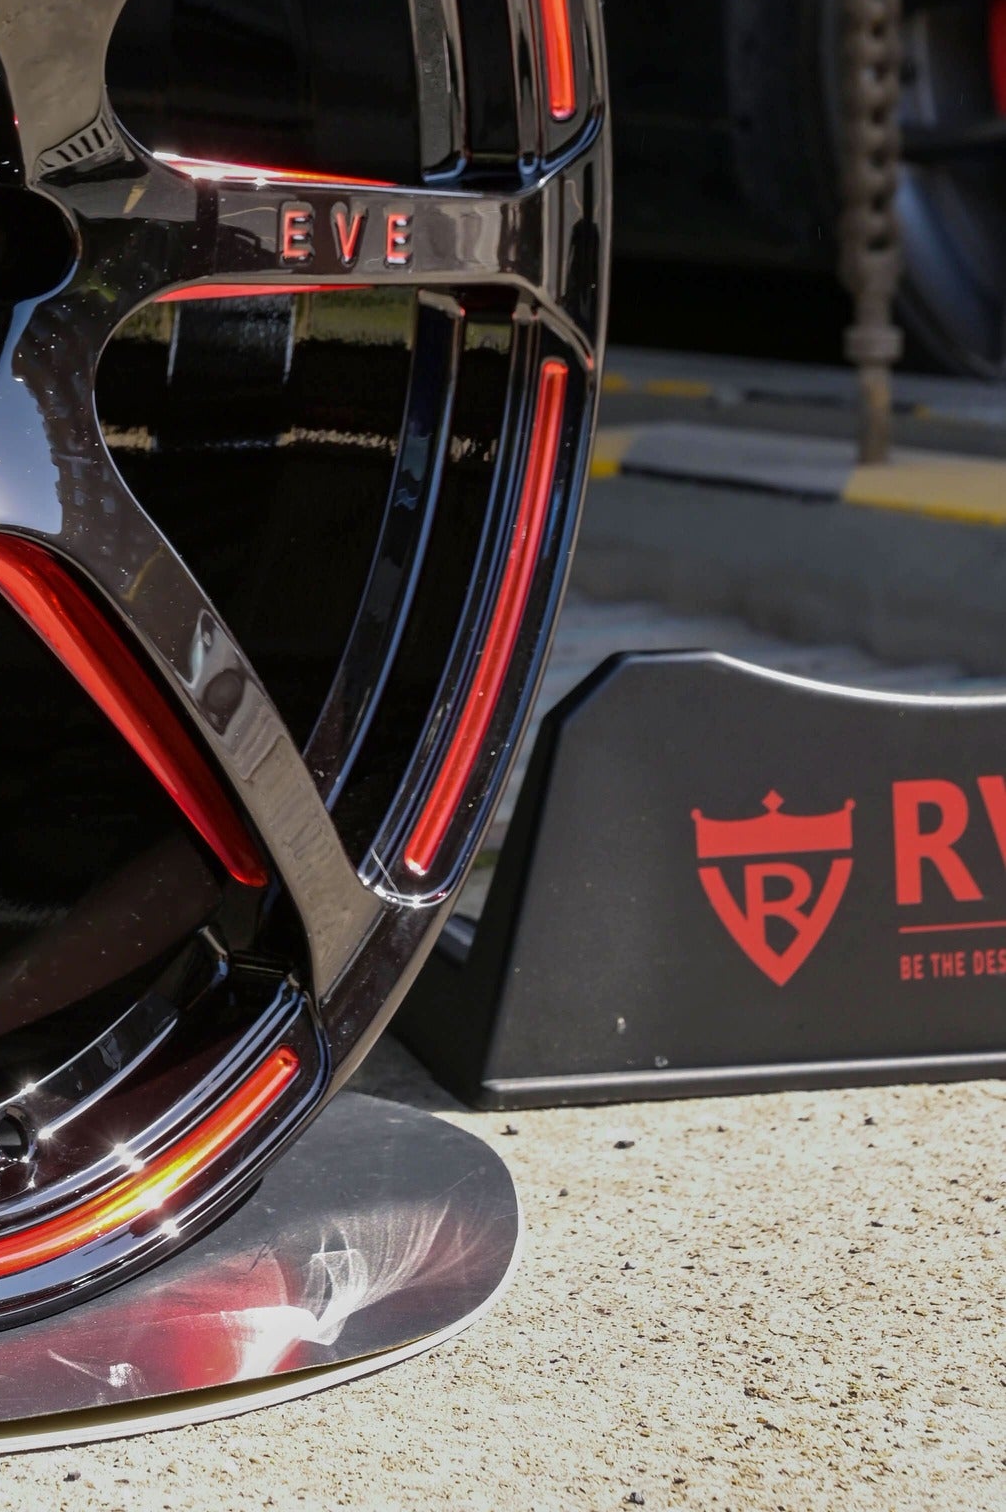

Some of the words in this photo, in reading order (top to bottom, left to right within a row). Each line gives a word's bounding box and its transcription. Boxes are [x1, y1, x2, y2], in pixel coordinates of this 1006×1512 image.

[281, 206, 412, 266] EVE
[900, 953, 924, 981] BE
[930, 950, 966, 978] THE
